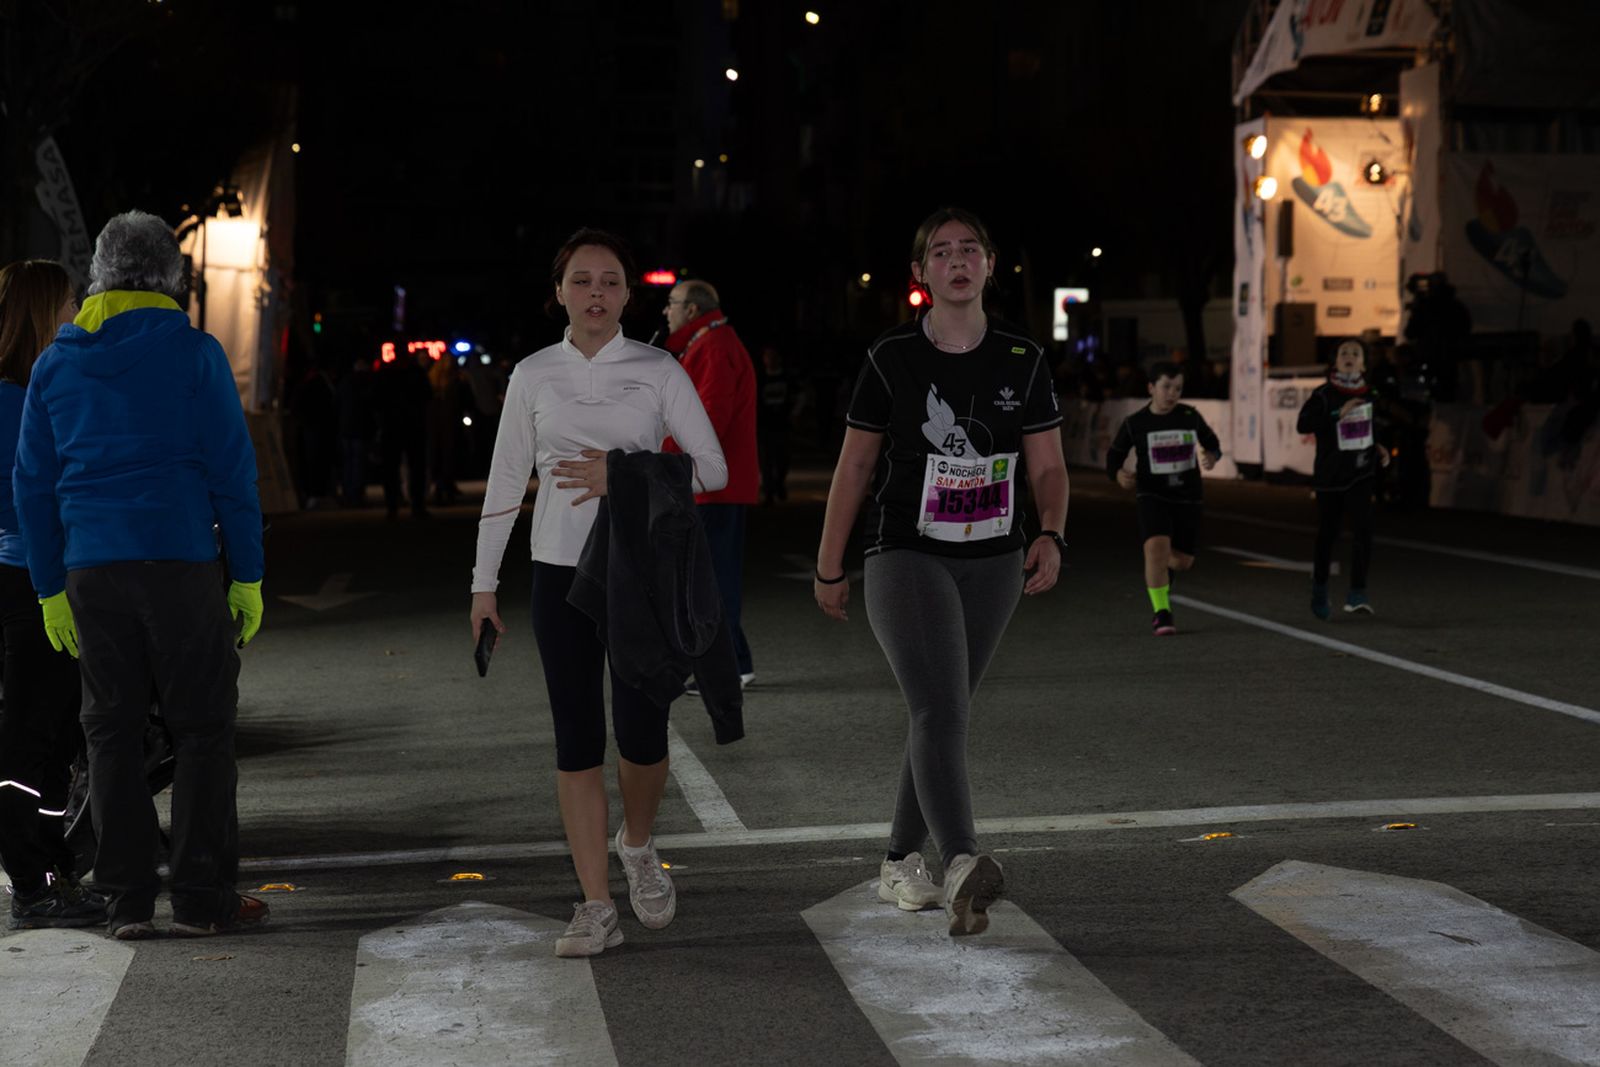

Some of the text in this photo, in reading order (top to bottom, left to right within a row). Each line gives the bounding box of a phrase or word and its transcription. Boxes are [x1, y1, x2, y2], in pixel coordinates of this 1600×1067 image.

[942, 432, 967, 458] 43
[936, 476, 957, 487] SAN
[938, 482, 1001, 514] 15344
